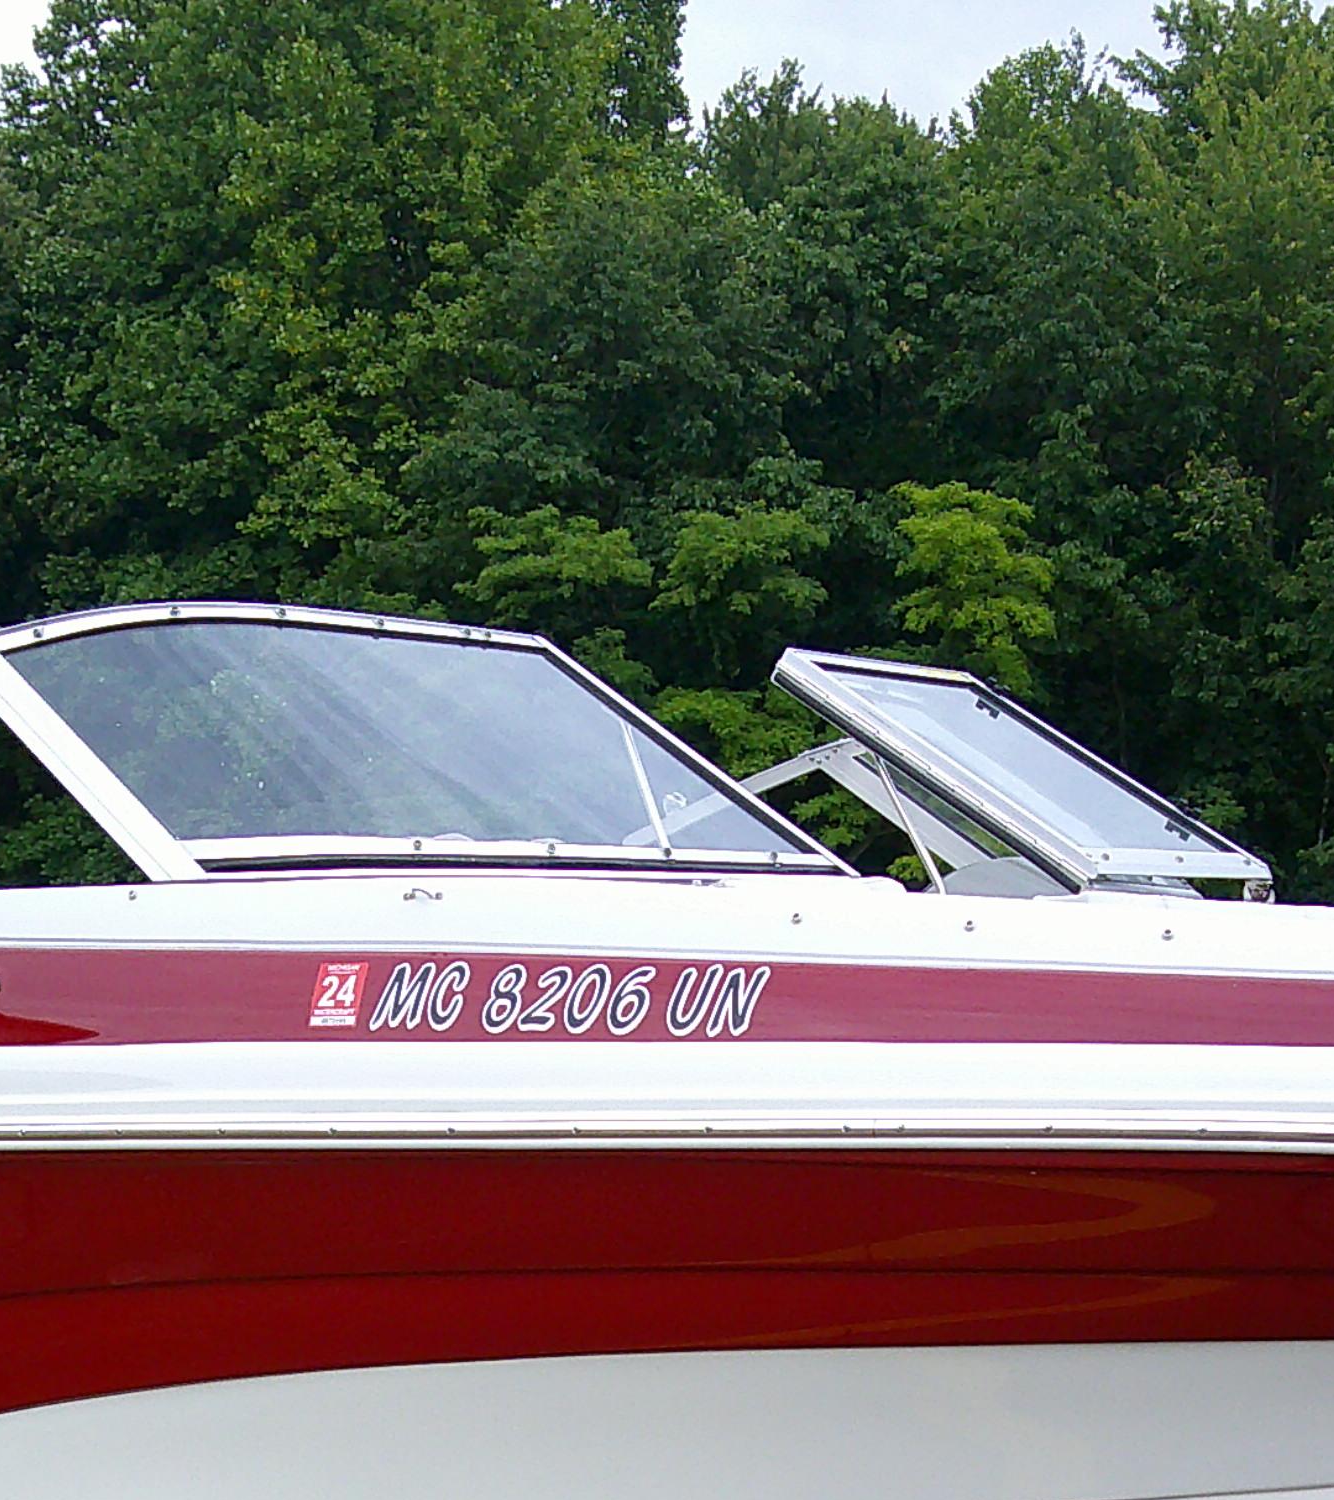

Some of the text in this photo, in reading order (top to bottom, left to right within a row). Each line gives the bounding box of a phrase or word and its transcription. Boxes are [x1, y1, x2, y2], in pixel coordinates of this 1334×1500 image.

[317, 974, 358, 1007] 24
[368, 960, 771, 1037] MC 8206 UN
